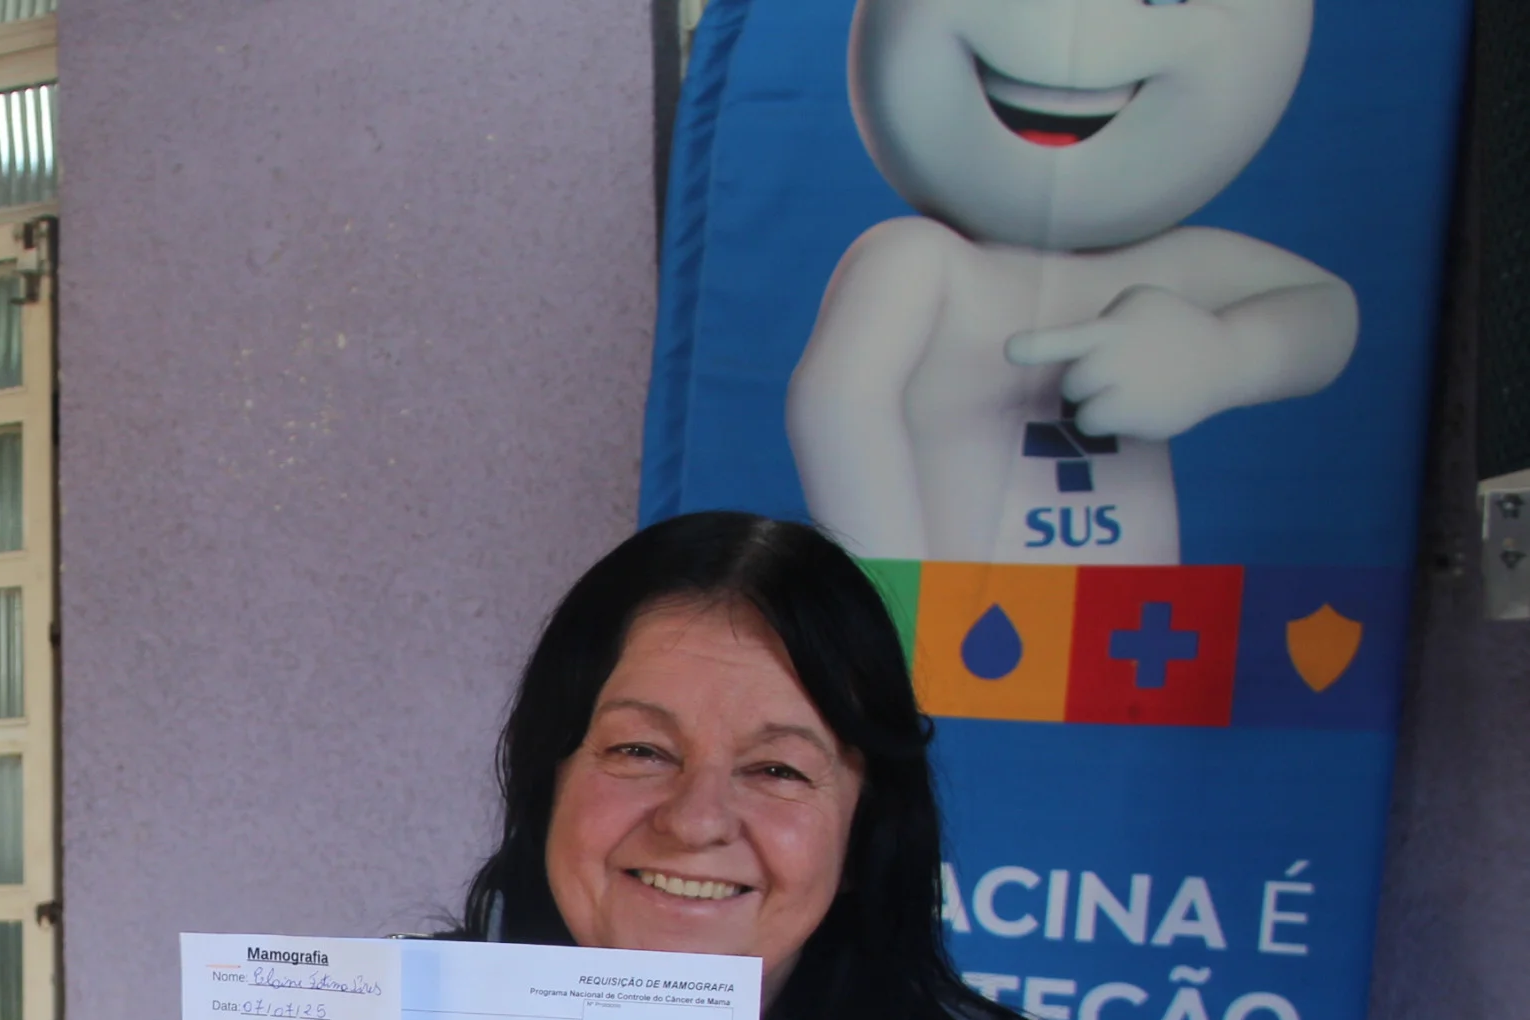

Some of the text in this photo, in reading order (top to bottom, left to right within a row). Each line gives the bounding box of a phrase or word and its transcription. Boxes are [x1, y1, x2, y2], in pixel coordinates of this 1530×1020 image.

[1024, 504, 1123, 548] SUS
[940, 859, 1314, 955] ACINA É
[247, 947, 329, 965] Mamografia
[212, 972, 248, 983] Nome:
[578, 976, 734, 992] REQUISIÇÃO DE MAMOGRAFIA
[530, 987, 568, 997] Programa
[569, 990, 604, 998] Nacional
[617, 992, 651, 1001] Controle
[653, 994, 664, 1002] do
[665, 995, 693, 1004] Câncer
[707, 998, 731, 1006] Mama
[212, 1000, 241, 1012] Data:
